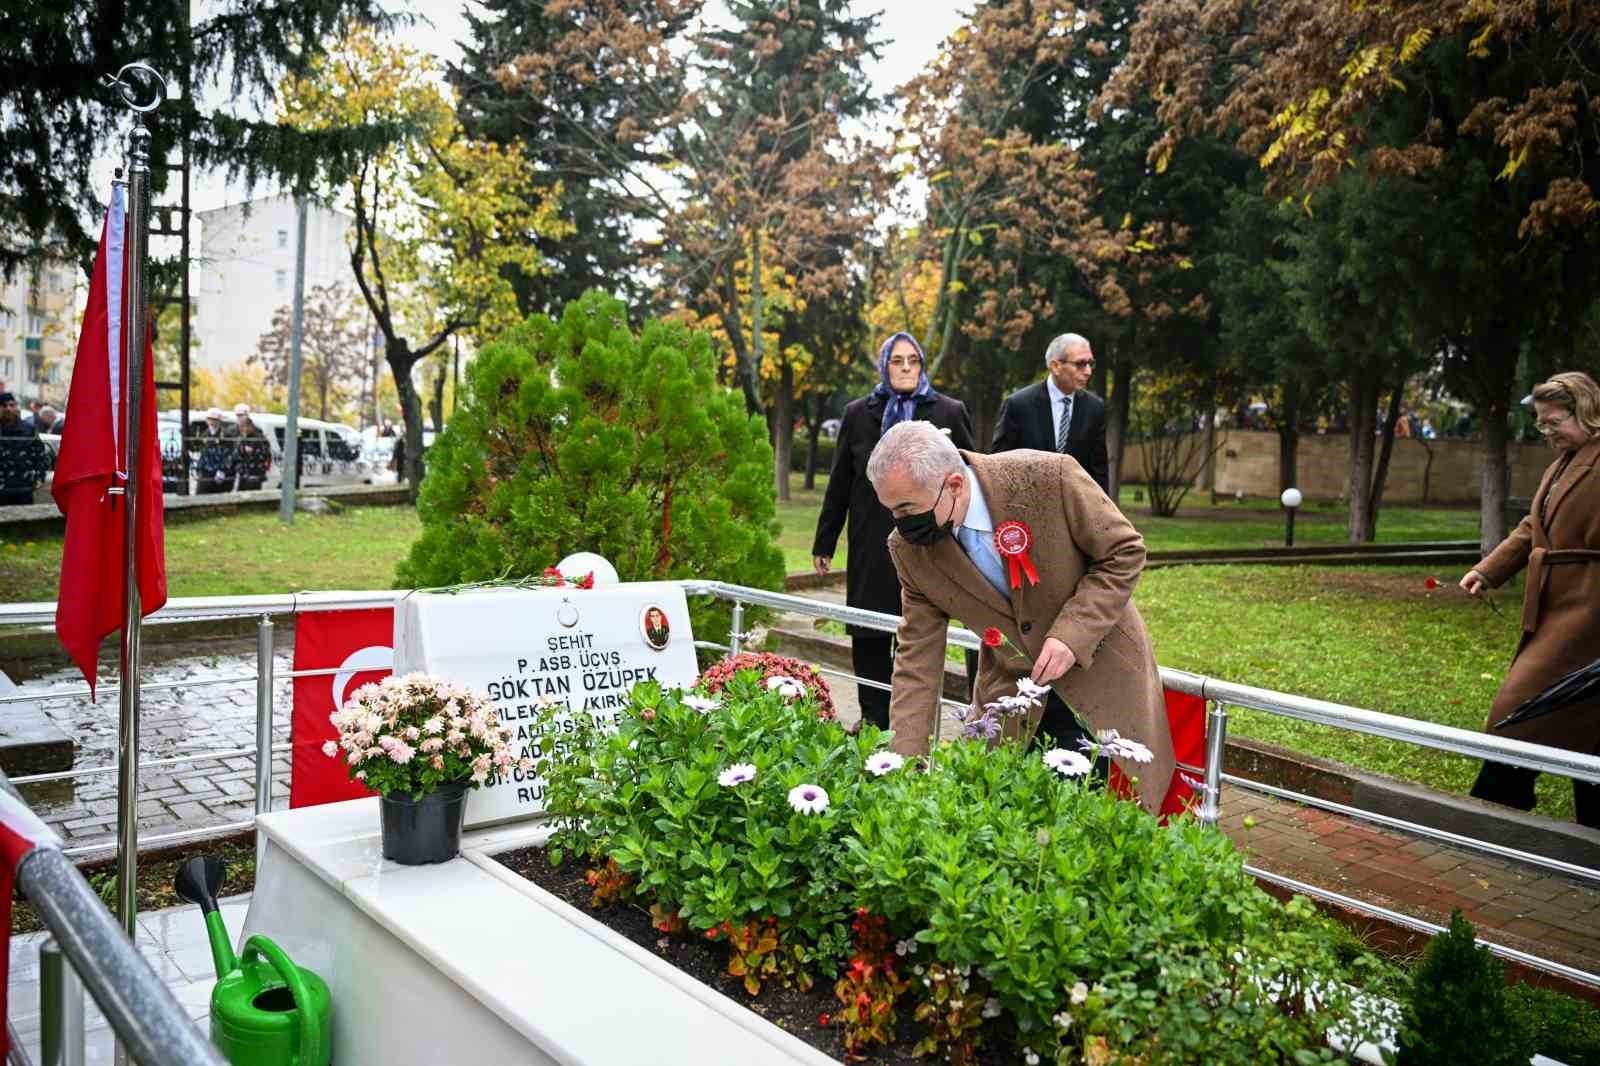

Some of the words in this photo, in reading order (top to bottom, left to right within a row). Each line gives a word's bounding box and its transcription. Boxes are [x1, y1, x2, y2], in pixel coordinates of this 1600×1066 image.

[547, 630, 594, 654] ŞEHİT
[487, 675, 572, 702] GÖKTAN
[582, 667, 657, 690] ÖZÜPEK
[520, 743, 548, 760] AD
